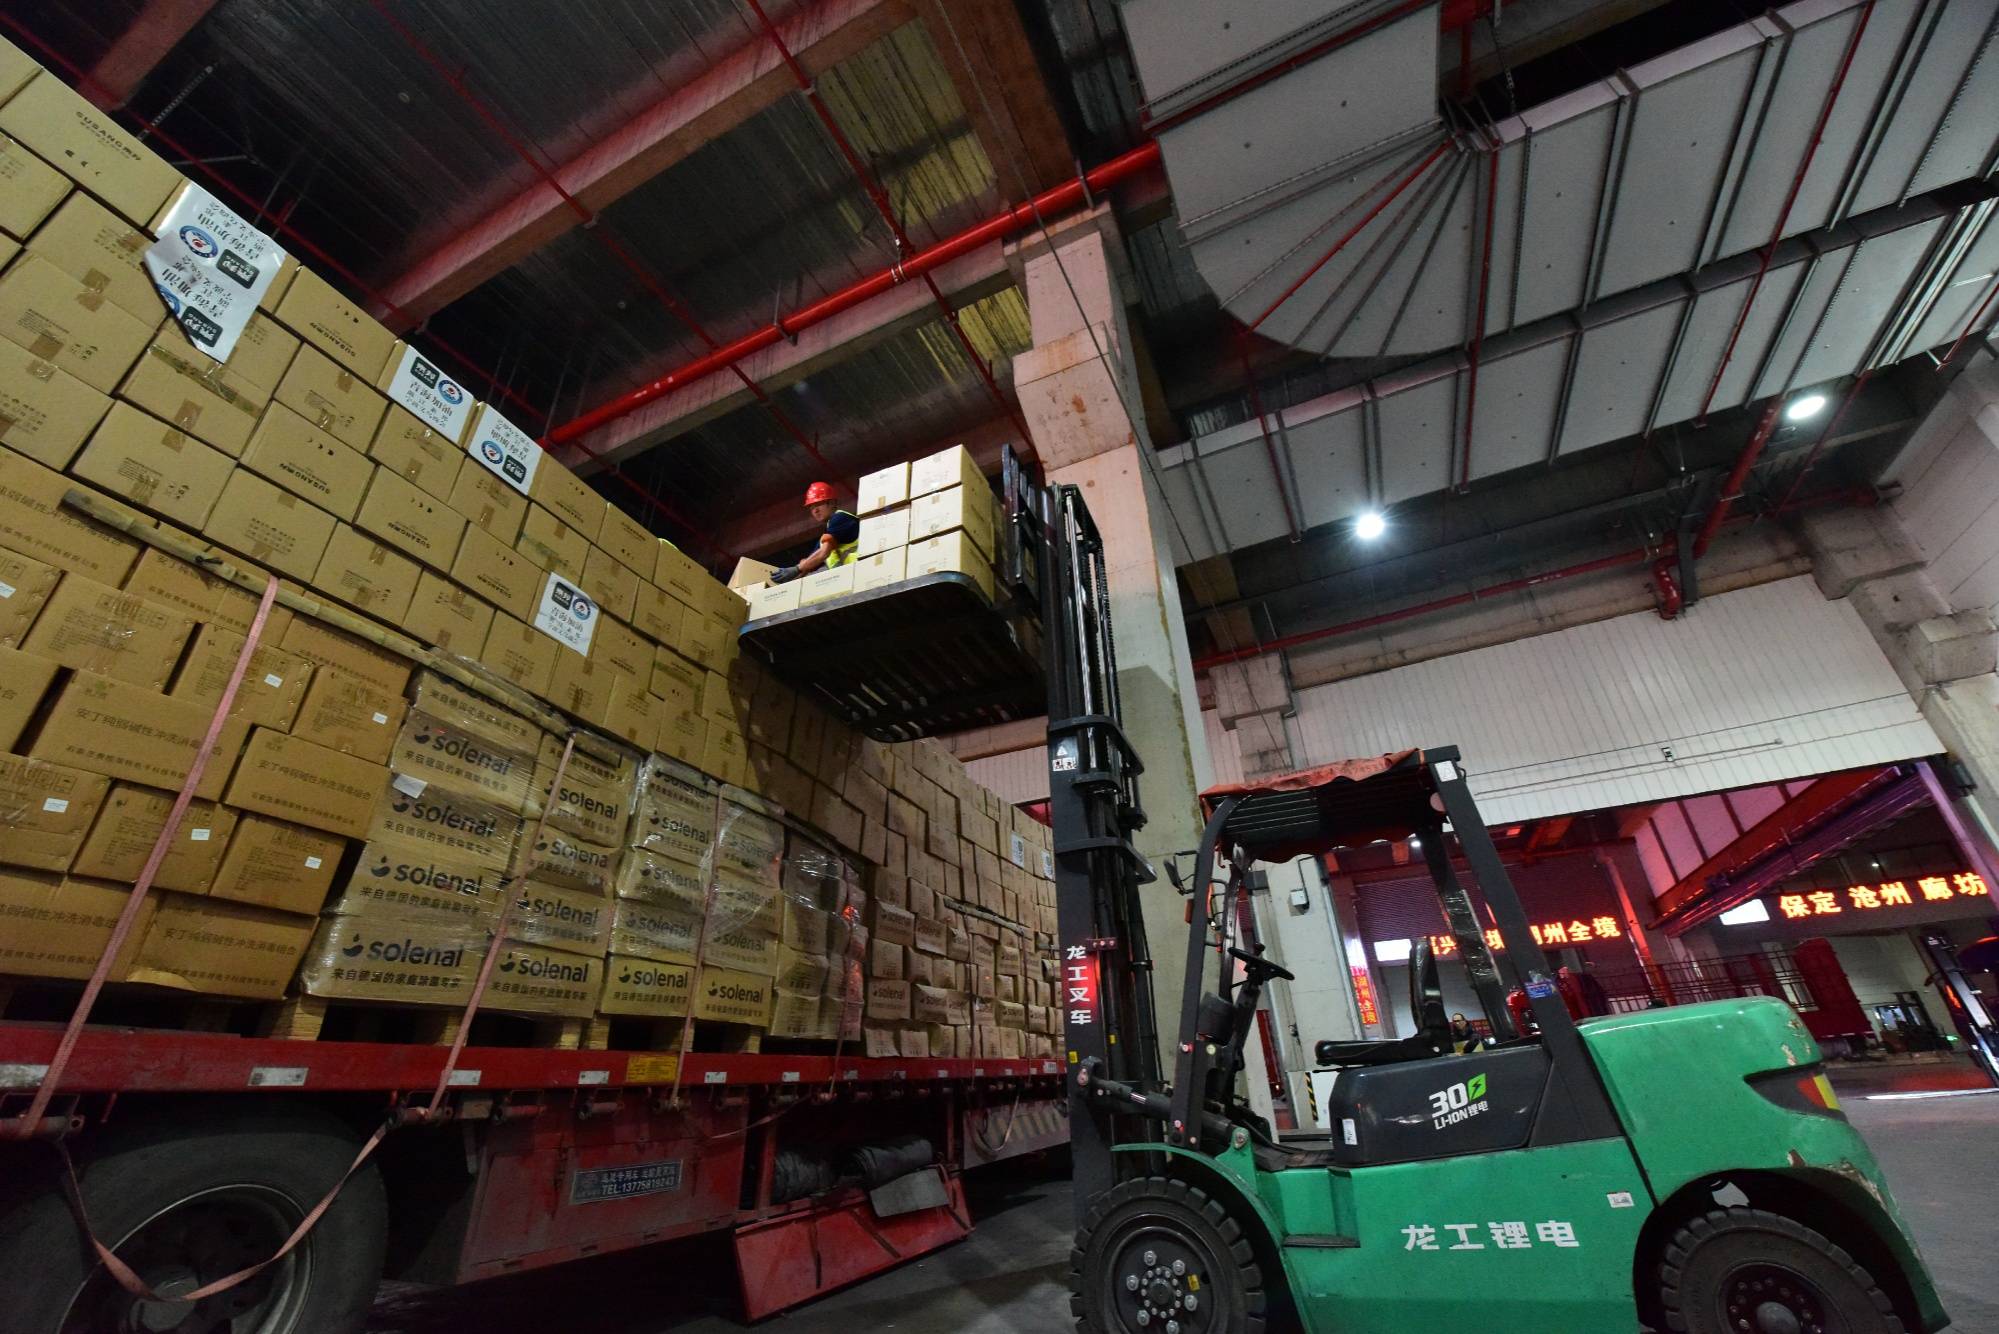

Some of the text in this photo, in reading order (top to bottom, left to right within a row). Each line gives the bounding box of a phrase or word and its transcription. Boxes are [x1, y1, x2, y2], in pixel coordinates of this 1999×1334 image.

[197, 213, 259, 259] 青海加油
[161, 268, 223, 317] 青海加油
[432, 735, 513, 774] solenal
[411, 799, 496, 837] solenal
[557, 787, 618, 819] solenal
[659, 816, 710, 844] solenal
[394, 864, 482, 895] solenal
[1780, 872, 1988, 918] 保定 沧州 廊坊
[530, 898, 598, 926] solenal
[637, 913, 692, 937] solenal
[367, 939, 463, 967] solenal
[722, 933, 765, 951] solenal
[517, 955, 588, 981] solenal
[632, 967, 688, 987] solenal
[718, 983, 763, 1002] solenal
[1066, 945, 1092, 1025] 龙工叉车
[1429, 1082, 1469, 1118] 30
[1434, 1108, 1468, 1130] LI-ION
[1401, 1220, 1580, 1251] 龙工锂电
